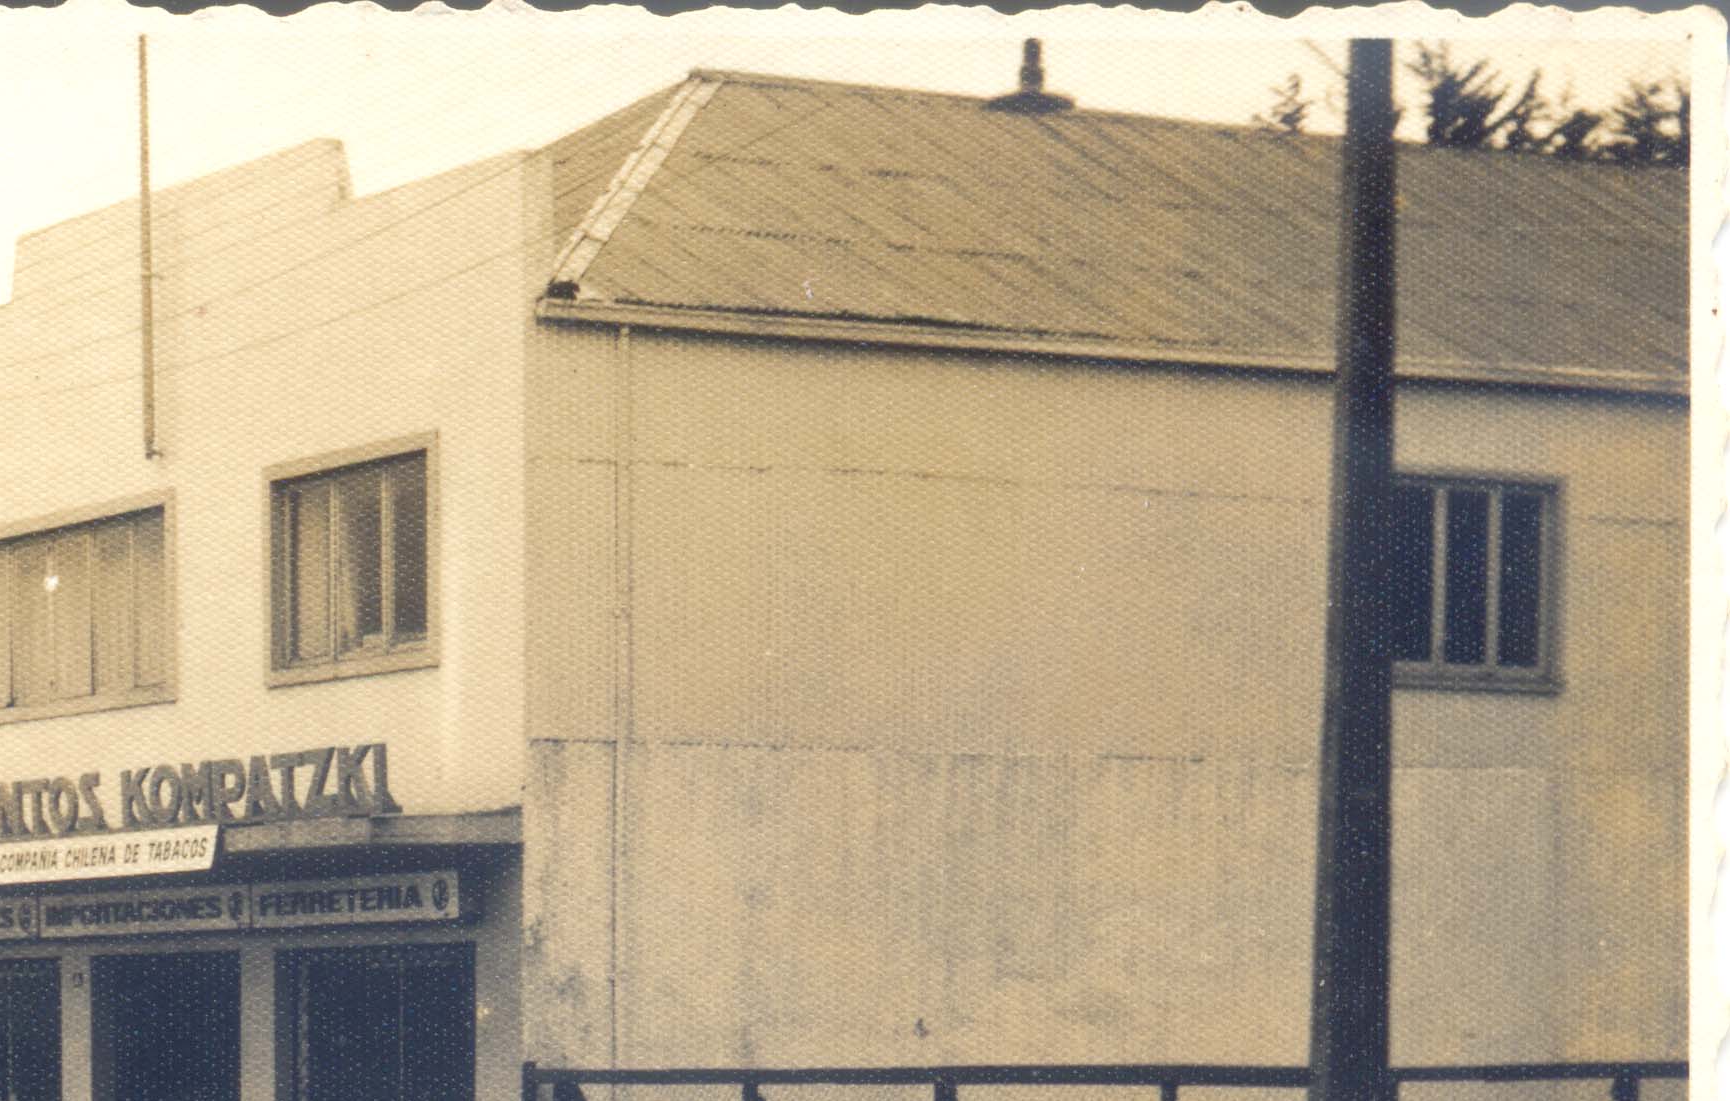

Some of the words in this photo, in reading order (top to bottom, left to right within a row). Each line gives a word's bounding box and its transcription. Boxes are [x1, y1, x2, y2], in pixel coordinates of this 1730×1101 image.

[120, 742, 390, 829] KOMPATZKI
[64, 844, 117, 870] CHILENA
[123, 842, 141, 865] DE
[148, 836, 209, 862] TABACOS
[45, 894, 223, 928] IMPORTACIONES
[258, 884, 424, 917] FERRETERIA
